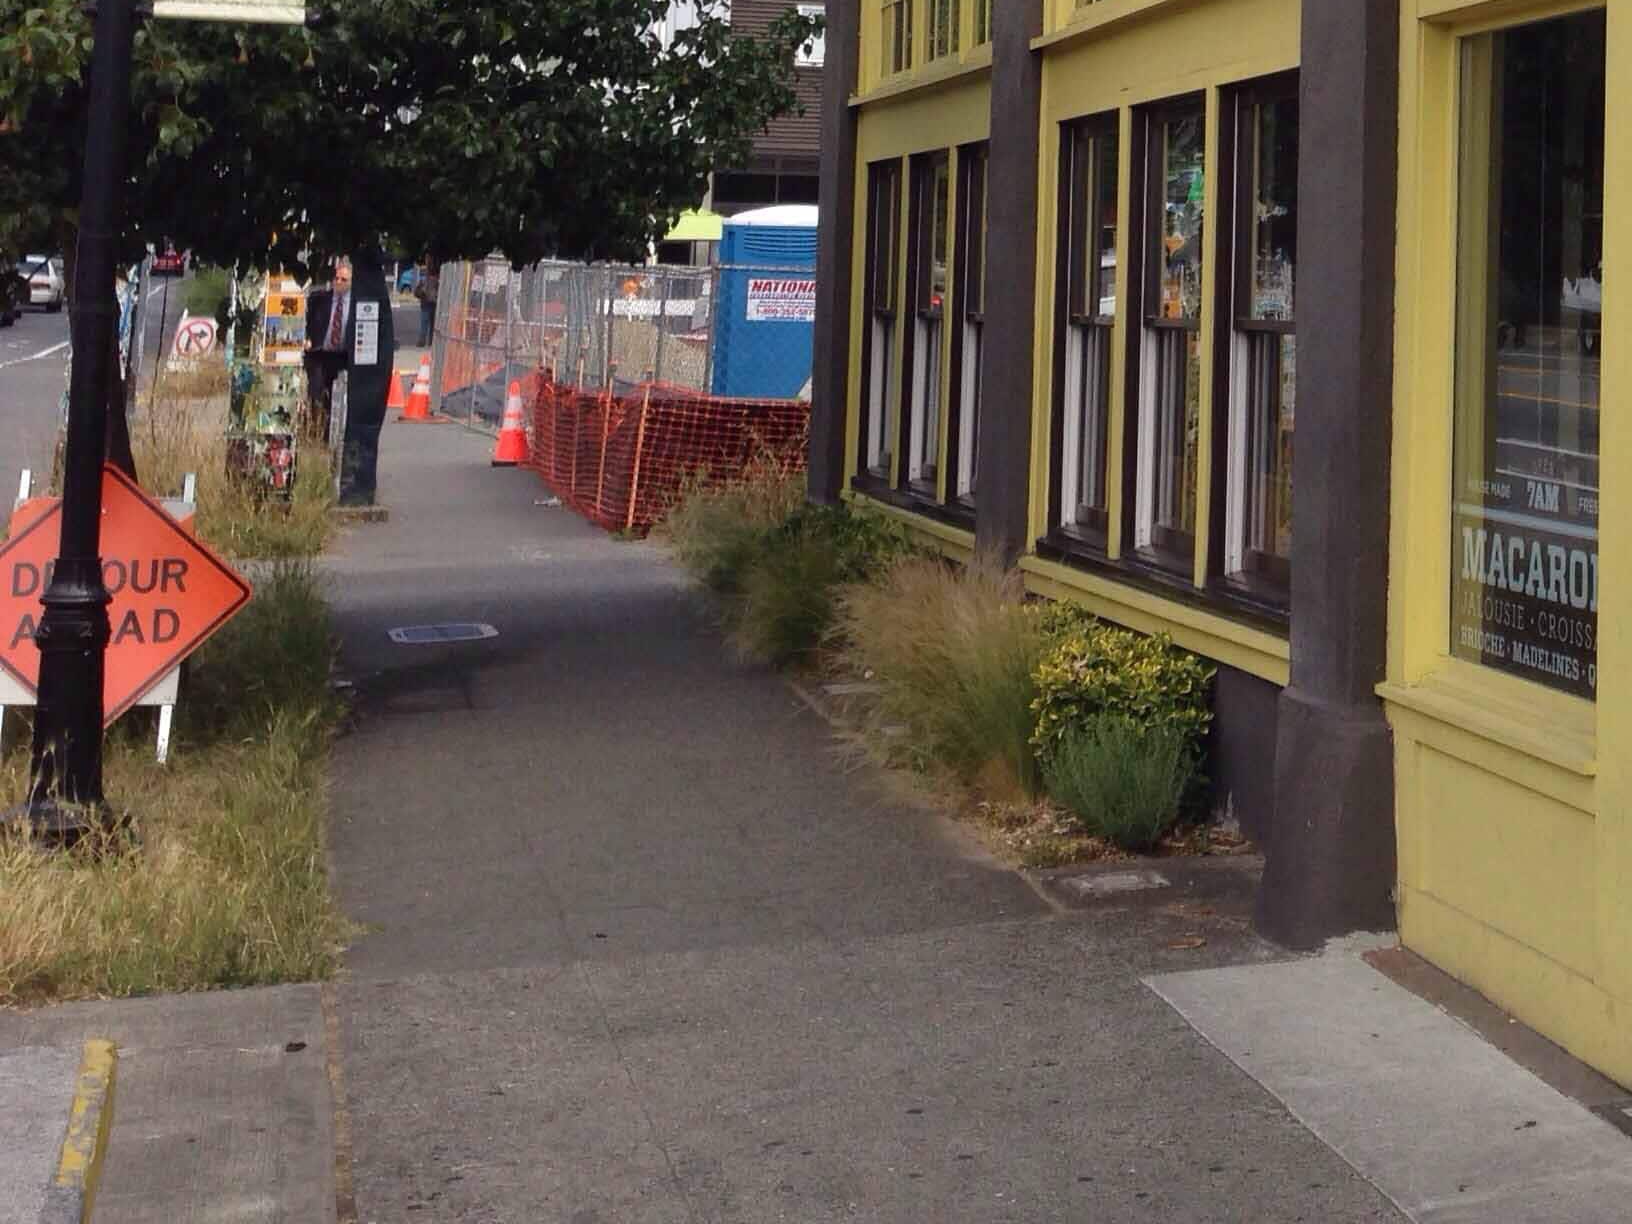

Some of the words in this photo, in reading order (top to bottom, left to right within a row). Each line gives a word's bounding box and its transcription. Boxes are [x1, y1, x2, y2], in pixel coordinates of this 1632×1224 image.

[1527, 480, 1560, 514] 7AM
[11, 558, 189, 598] DOUR
[8, 608, 181, 651] AAD
[1463, 591, 1526, 631] JALOUSIE
[1460, 626, 1505, 658] BRIOCHE
[1512, 640, 1580, 681] MADELINES
